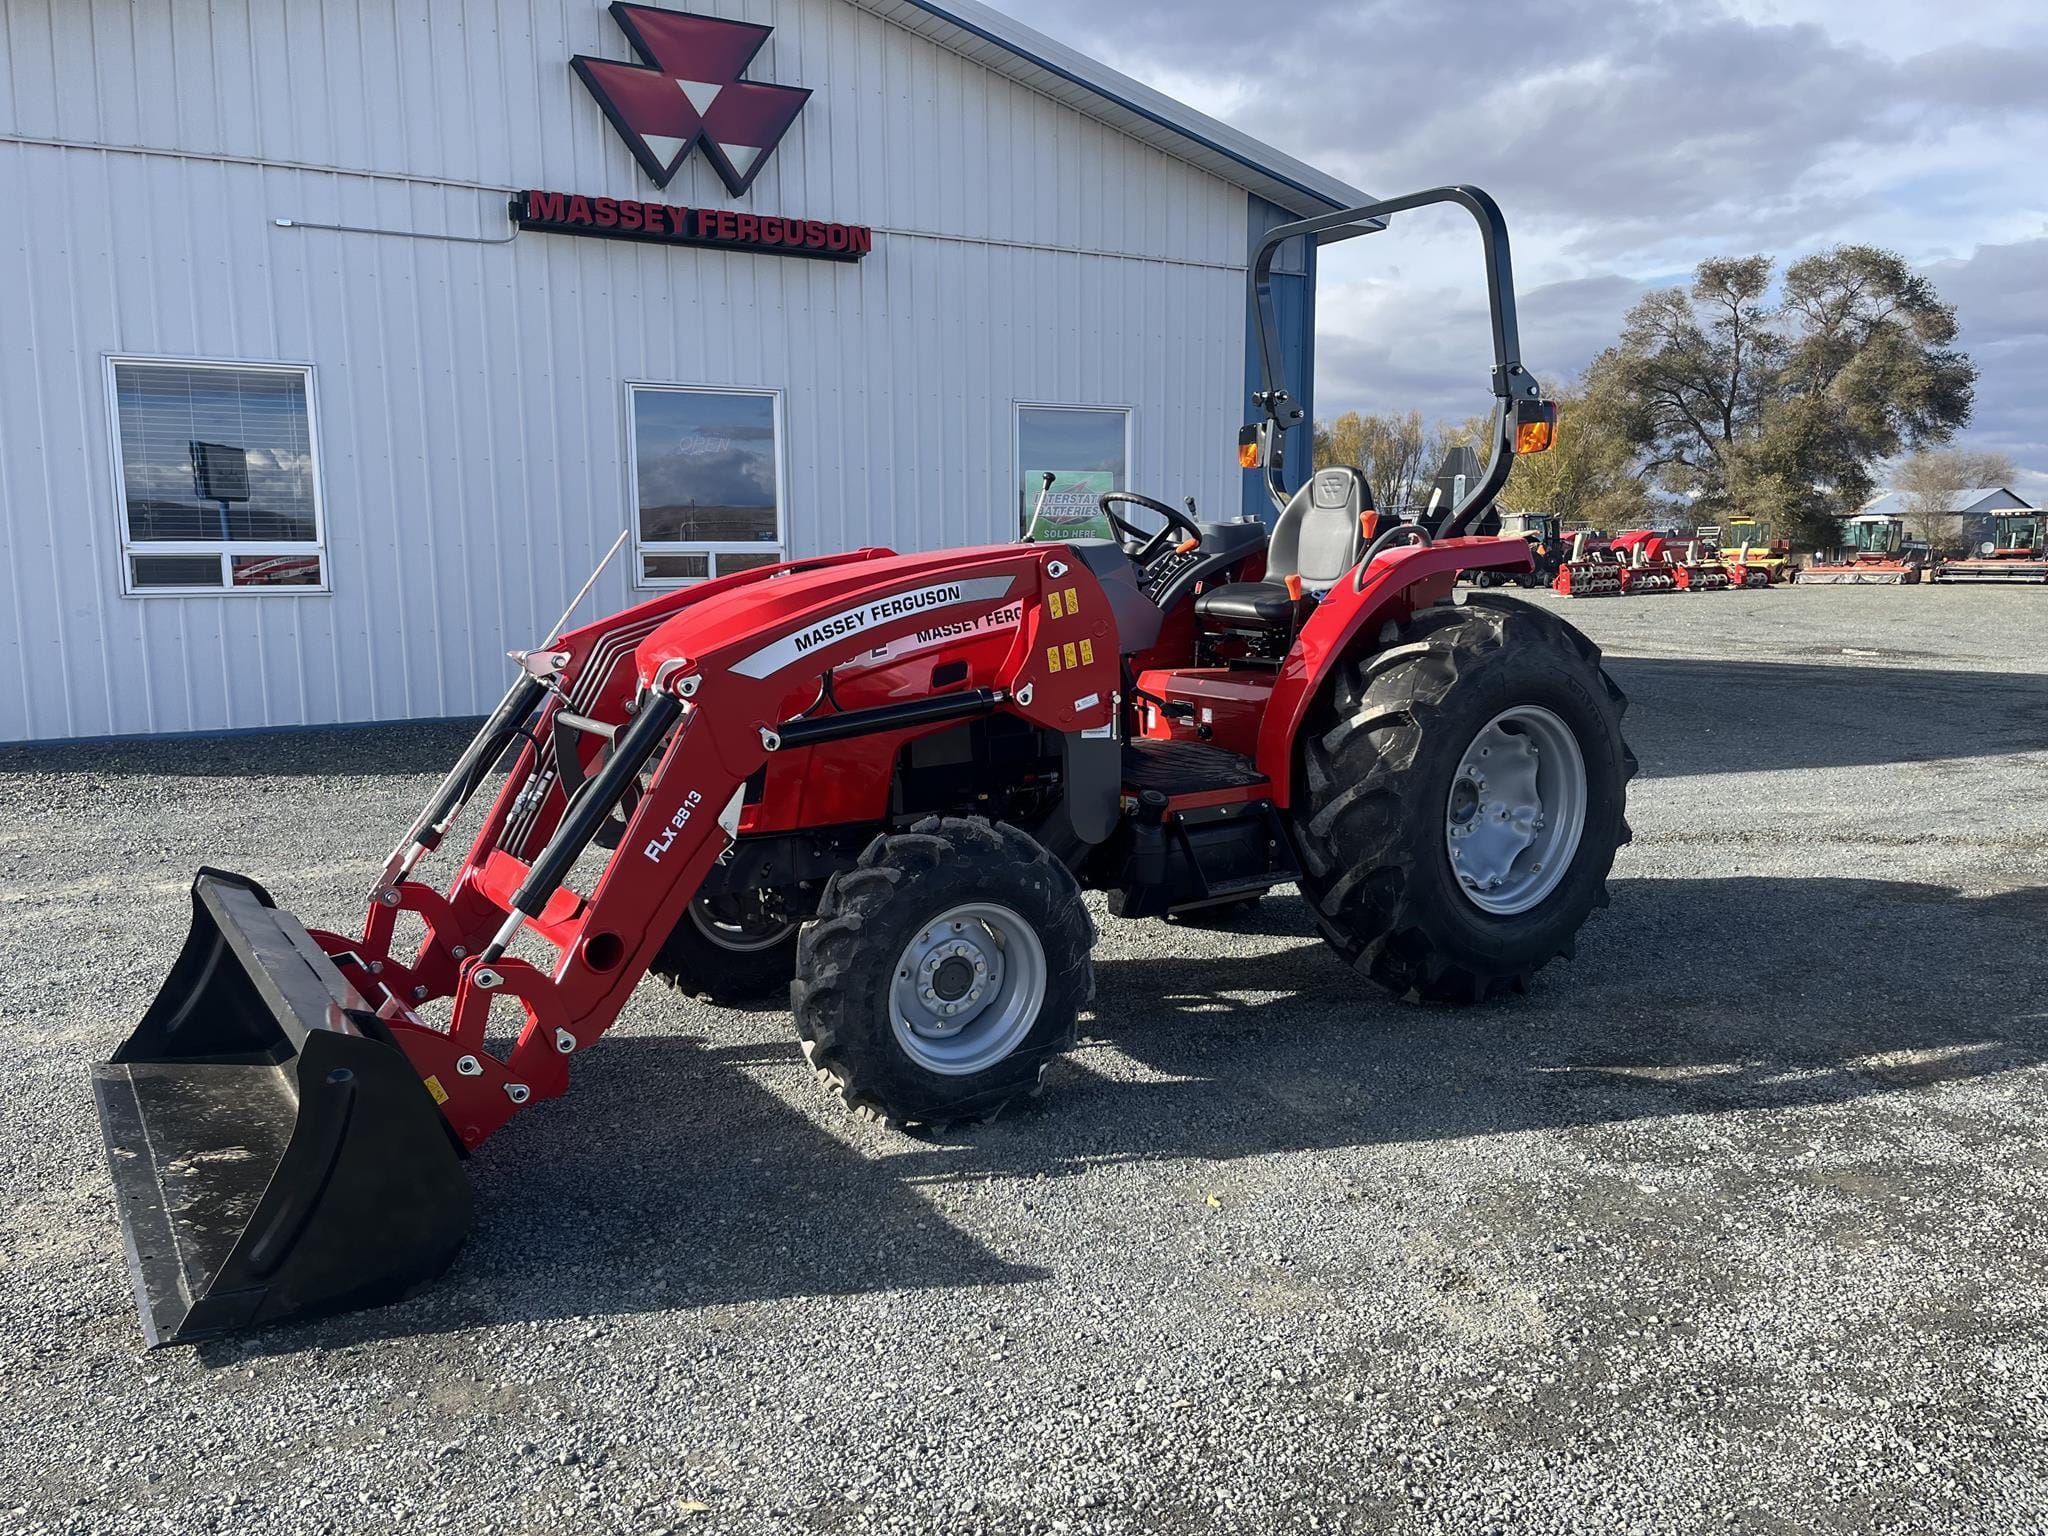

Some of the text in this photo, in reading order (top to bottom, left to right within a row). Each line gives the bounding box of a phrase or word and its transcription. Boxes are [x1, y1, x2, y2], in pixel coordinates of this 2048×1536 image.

[528, 190, 872, 253] MASSEY FERGUSON
[1034, 493, 1100, 504] ITERSTAT
[1044, 529, 1097, 538] SOLD HERE
[794, 610, 866, 652] MASSEY
[870, 586, 961, 622] FERGUSON
[916, 618, 980, 643] MASSEY
[643, 790, 702, 864] FLX 2813
